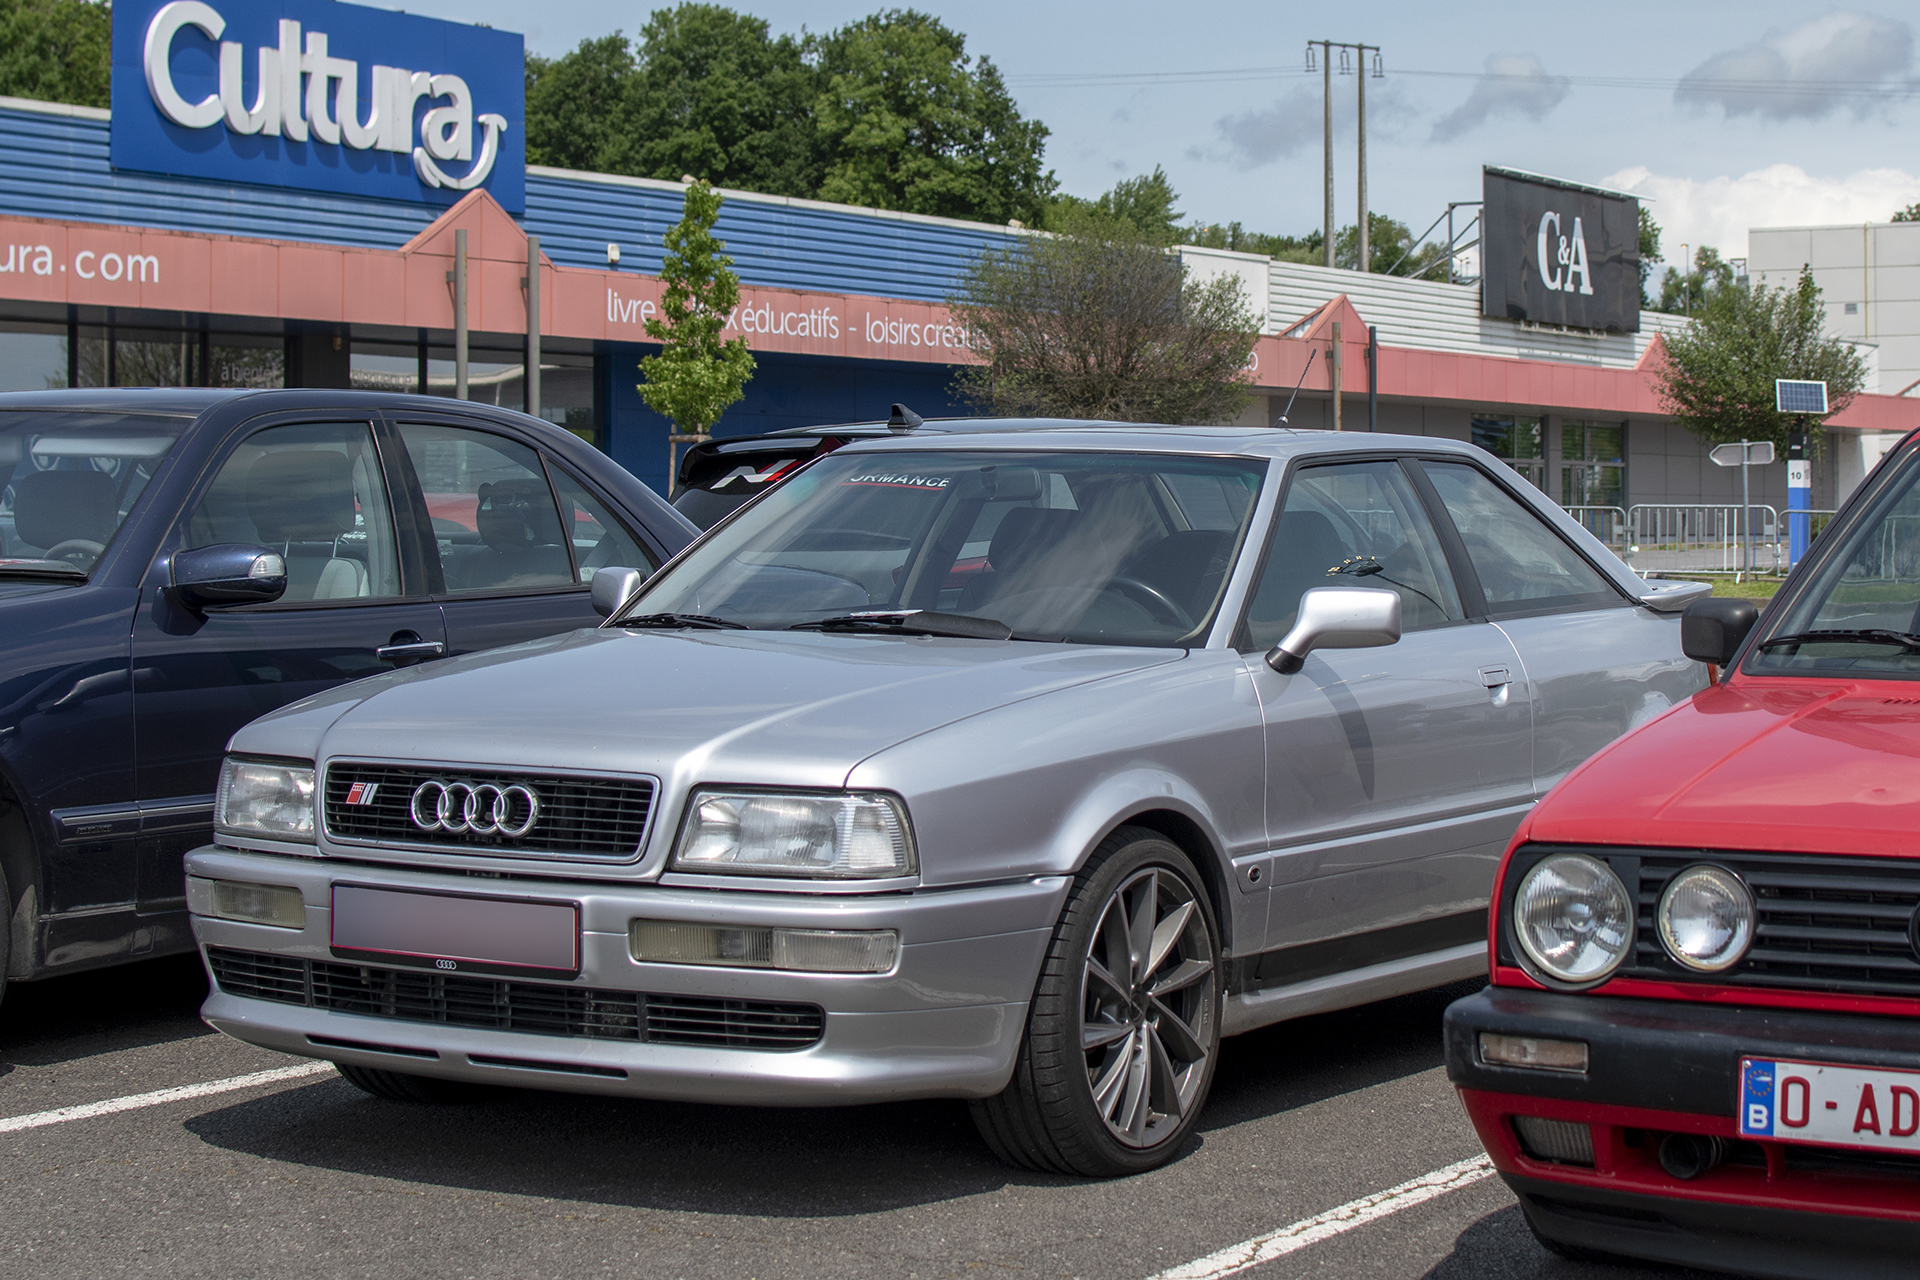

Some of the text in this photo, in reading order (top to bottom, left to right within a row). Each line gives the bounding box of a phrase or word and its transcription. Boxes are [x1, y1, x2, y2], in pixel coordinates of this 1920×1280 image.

[144, 0, 473, 162] Cultura
[1537, 211, 1594, 296] C&A
[741, 301, 840, 340] éducatifs
[866, 311, 921, 347] loisirs
[1790, 471, 1802, 480] 10
[1748, 1103, 1769, 1130] B
